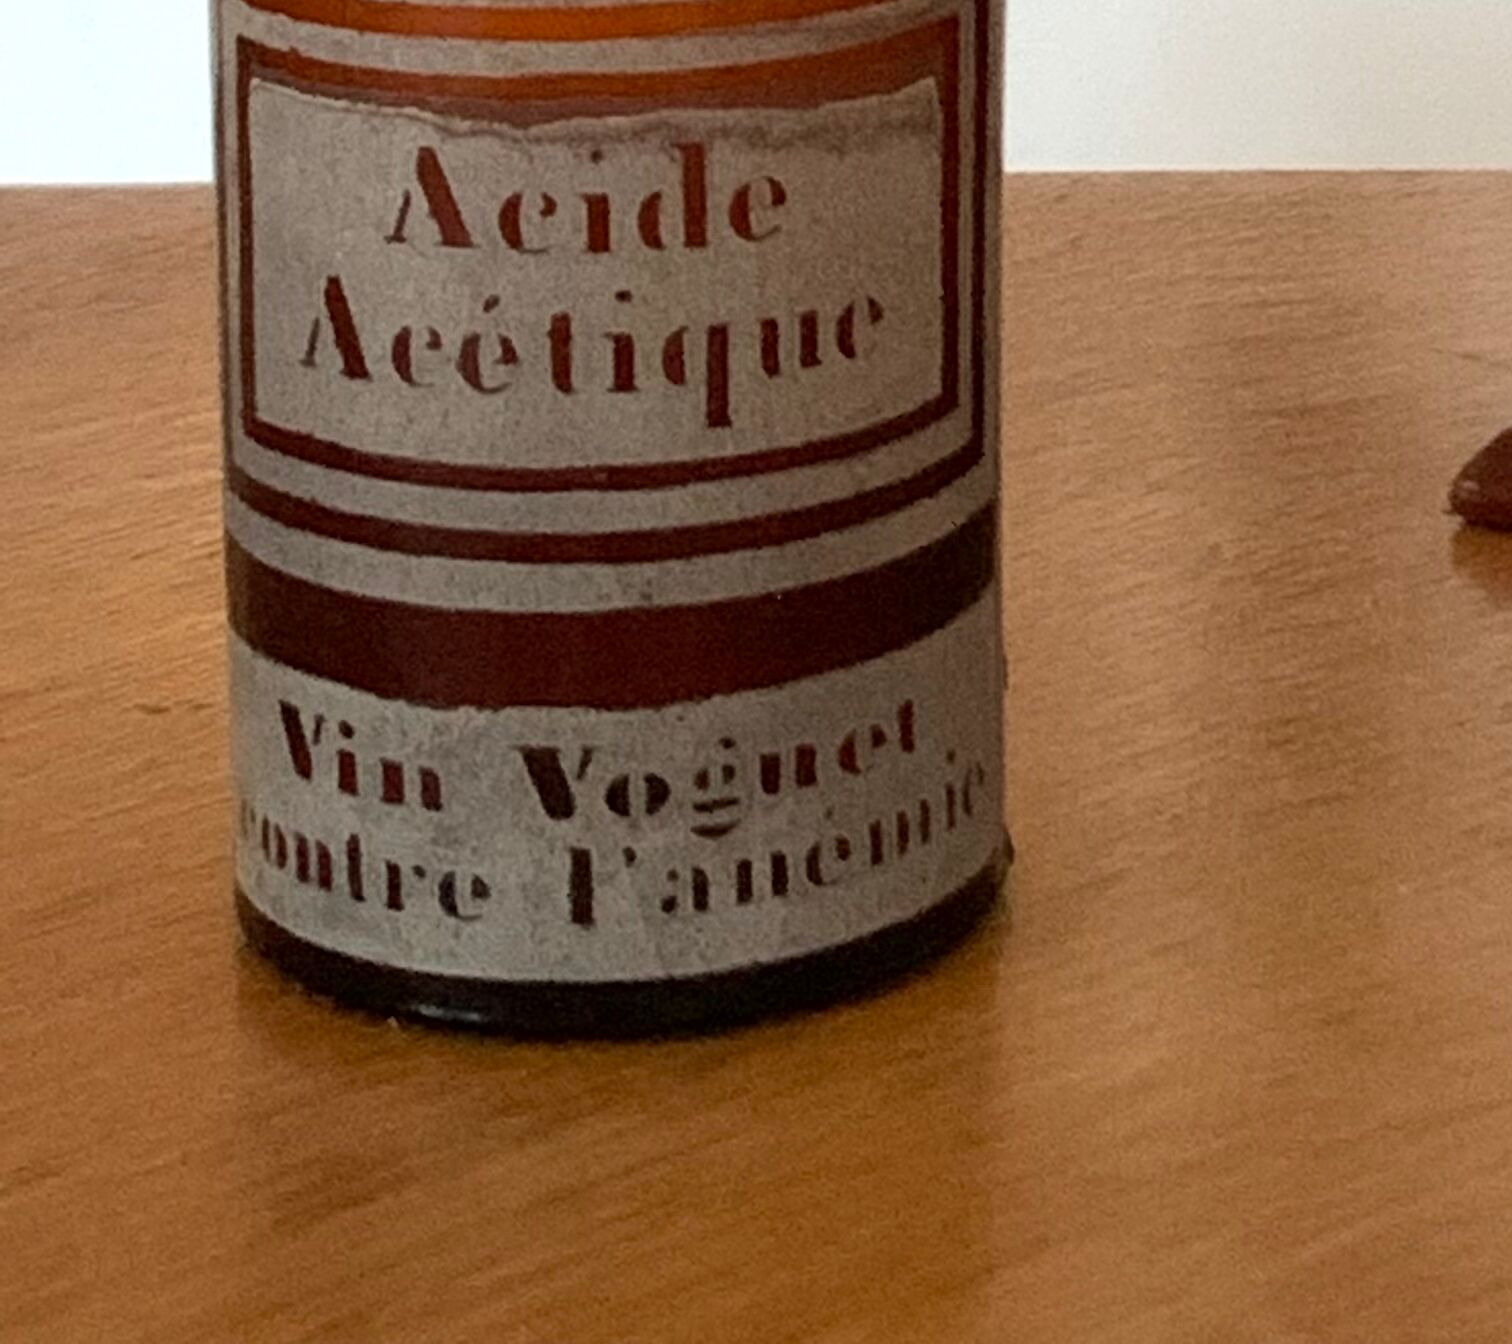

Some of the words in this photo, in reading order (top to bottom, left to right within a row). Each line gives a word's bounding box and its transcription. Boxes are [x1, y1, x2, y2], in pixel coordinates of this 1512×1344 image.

[384, 141, 789, 255] Acide
[299, 275, 885, 428] Acétique
[278, 699, 443, 813] Vin
[514, 698, 917, 839] Voguet
